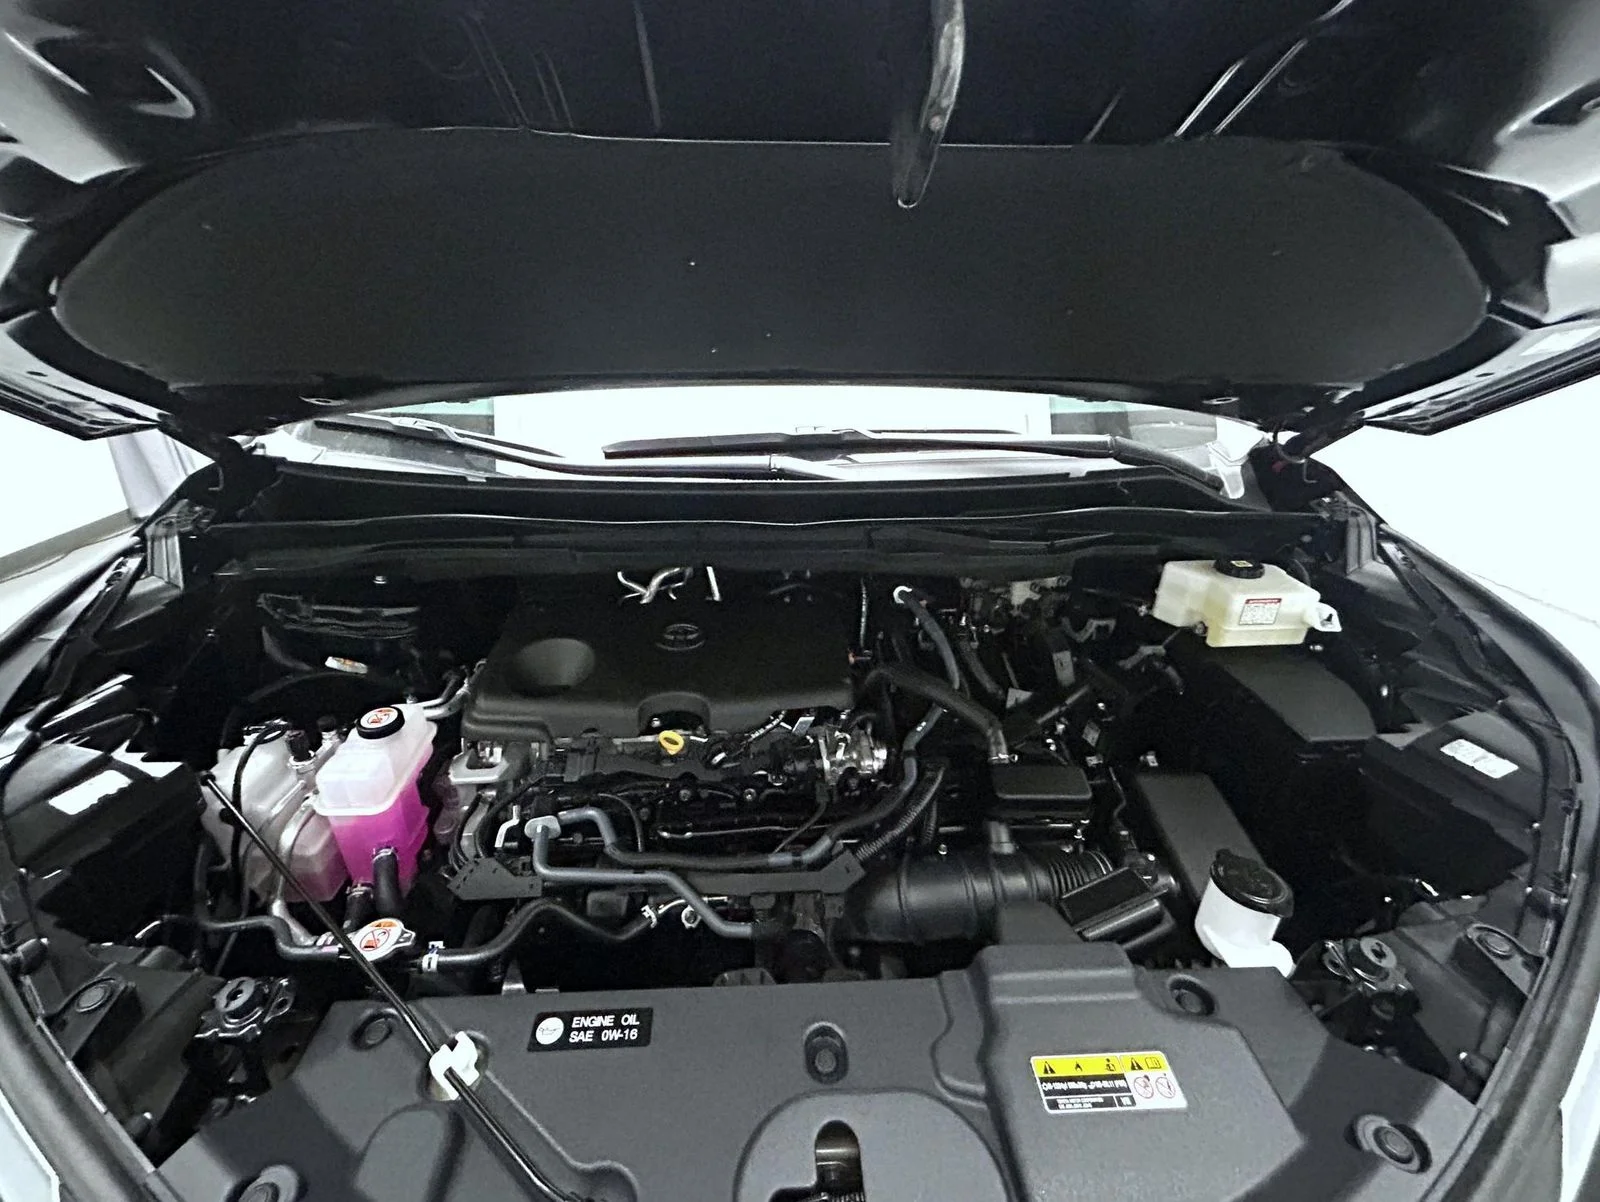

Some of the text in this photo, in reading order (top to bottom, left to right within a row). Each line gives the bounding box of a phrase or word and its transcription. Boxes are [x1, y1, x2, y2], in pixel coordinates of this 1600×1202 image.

[571, 1014, 640, 1028] ENGINE OIL
[568, 1028, 638, 1043] SAE 0W-16
